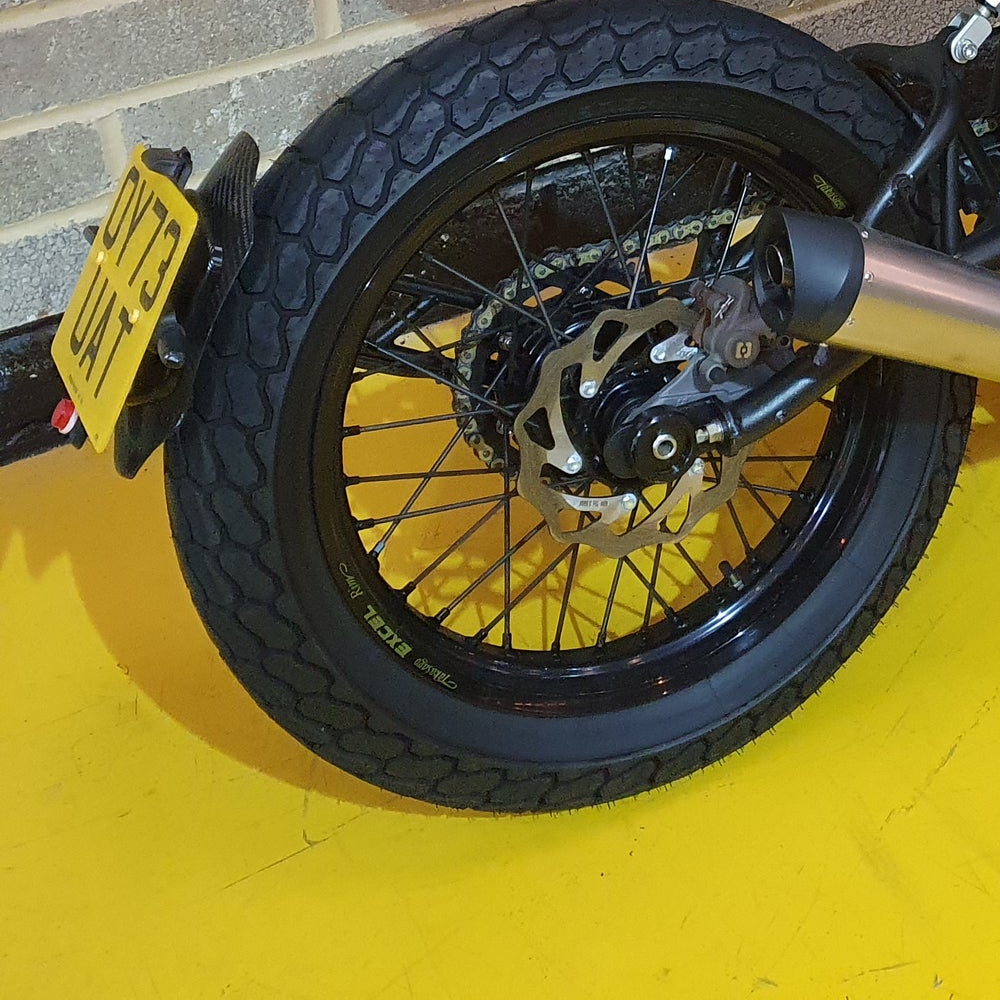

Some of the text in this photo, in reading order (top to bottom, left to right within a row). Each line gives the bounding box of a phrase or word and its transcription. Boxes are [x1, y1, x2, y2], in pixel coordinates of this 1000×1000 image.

[102, 165, 182, 313] OY73
[69, 264, 134, 399] UAT
[363, 604, 413, 659] EXCEL
[413, 657, 458, 690] Takasago
